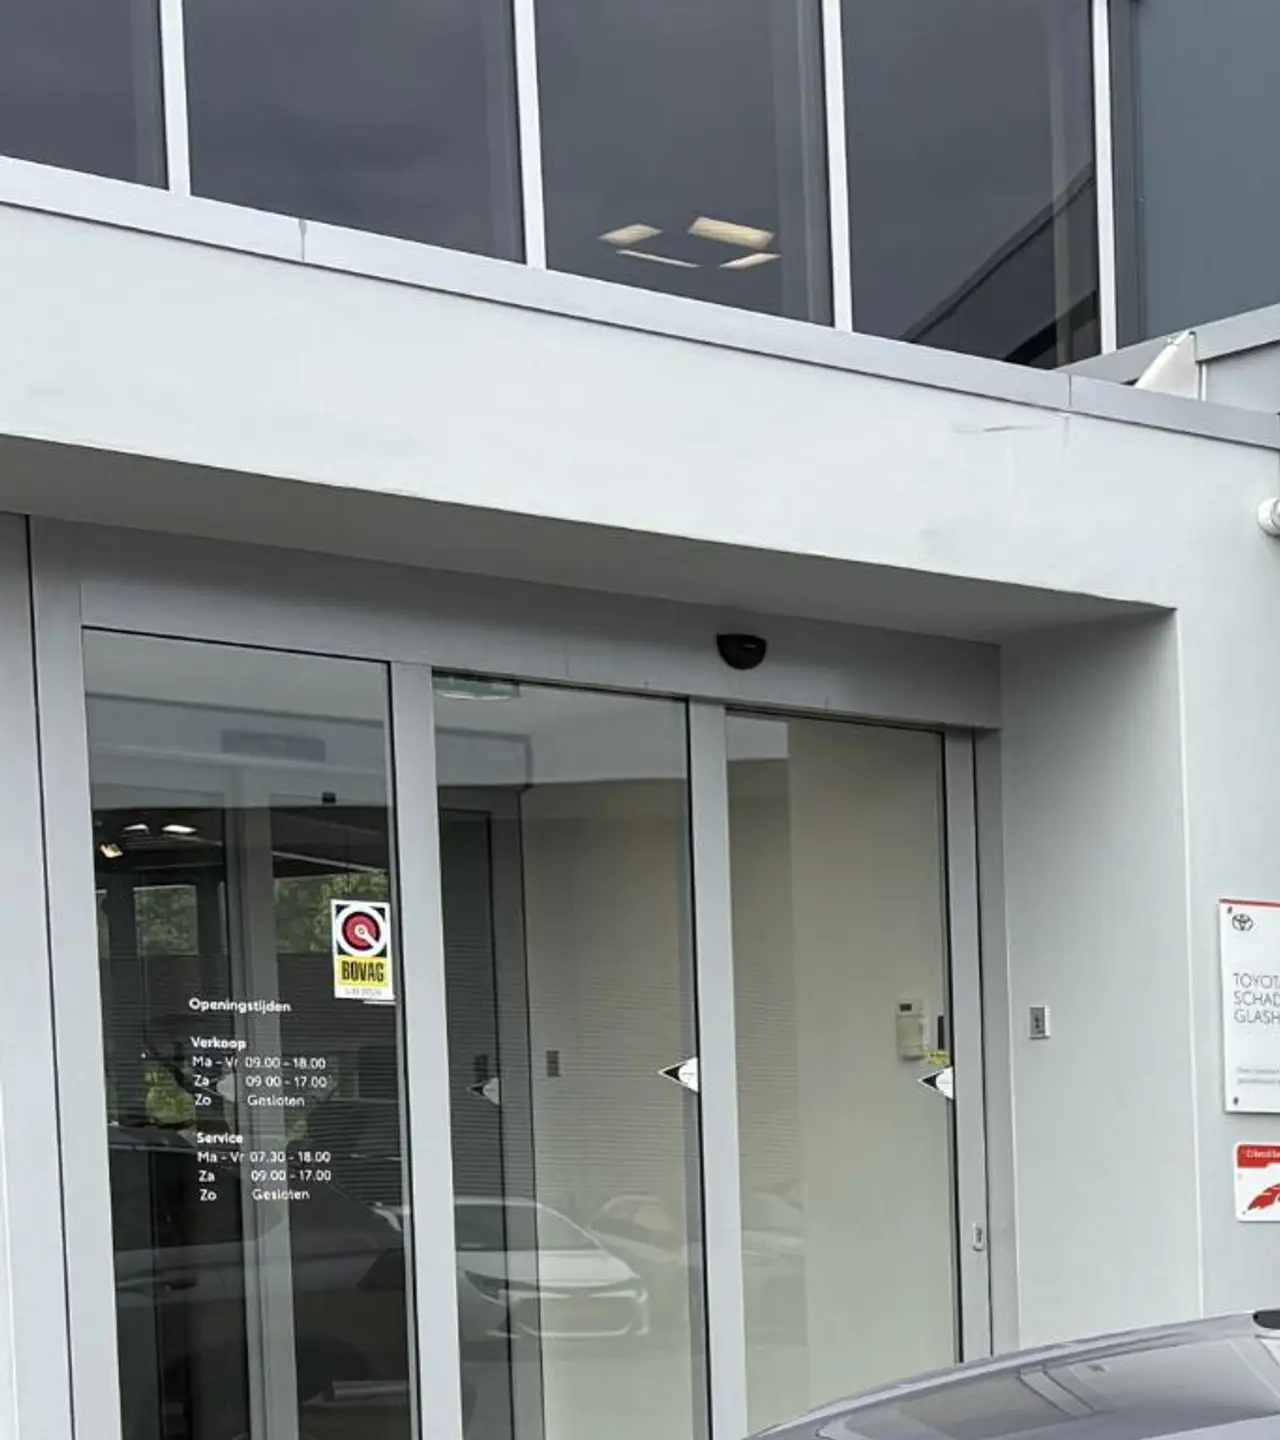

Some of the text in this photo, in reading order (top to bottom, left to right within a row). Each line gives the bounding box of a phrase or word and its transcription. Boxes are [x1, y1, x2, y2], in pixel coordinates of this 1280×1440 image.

[341, 960, 385, 982] BOVAG
[189, 997, 292, 1015] Openingstijden
[190, 1036, 247, 1051] Verkoop
[192, 1056, 213, 1068] Ma
[224, 1056, 238, 1068] Vr
[244, 1056, 281, 1069] 09.00
[292, 1057, 327, 1069] 18.00
[193, 1075, 210, 1087] Za
[294, 1076, 328, 1088] 17.00
[195, 1093, 305, 1107] Zo Gesloten
[197, 1132, 244, 1144] Service
[197, 1151, 218, 1163] Ma
[230, 1152, 245, 1163] Vr
[298, 1151, 332, 1163] 18.00
[198, 1170, 216, 1182] Za
[251, 1170, 287, 1182] 09.00
[300, 1170, 332, 1182] 17.00
[200, 1188, 310, 1201] Zo Gesloten
